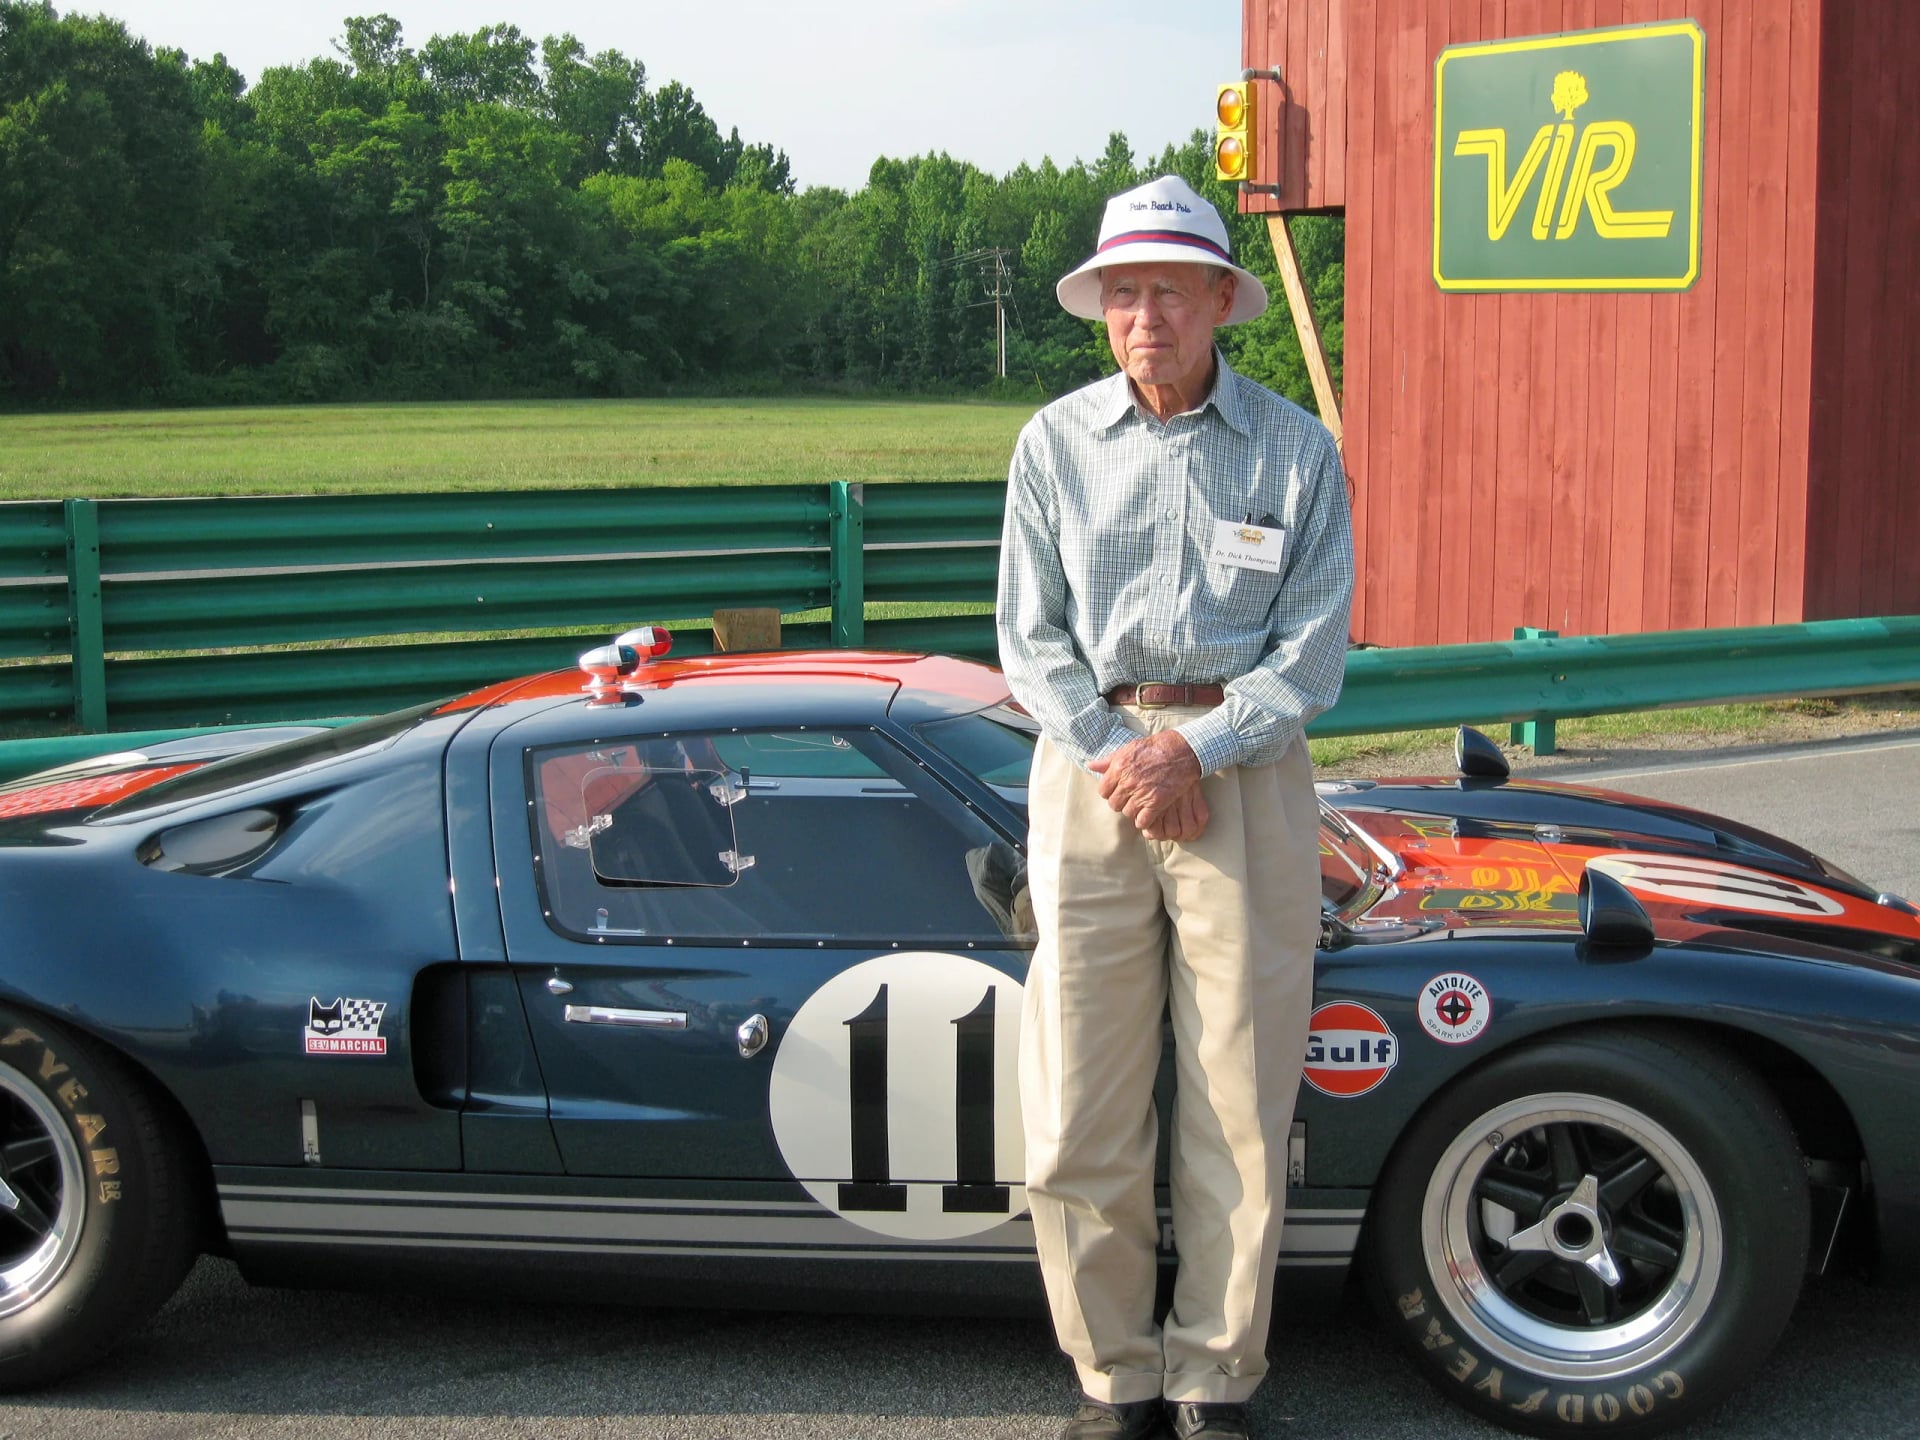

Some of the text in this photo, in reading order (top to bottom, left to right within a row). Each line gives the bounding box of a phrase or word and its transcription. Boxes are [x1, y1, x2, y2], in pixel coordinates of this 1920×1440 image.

[1454, 121, 1674, 240] VIR
[1130, 200, 1191, 213] Palm Beach Polo
[1227, 551, 1242, 560] Dick
[1244, 554, 1277, 565] Thompson
[1429, 976, 1482, 999] AUTOLITE
[1427, 1019, 1482, 1039] SPARK PLUGS
[329, 1040, 383, 1051] MARCHAL
[1305, 1036, 1391, 1062] Gulf
[838, 983, 1010, 1213] 11
